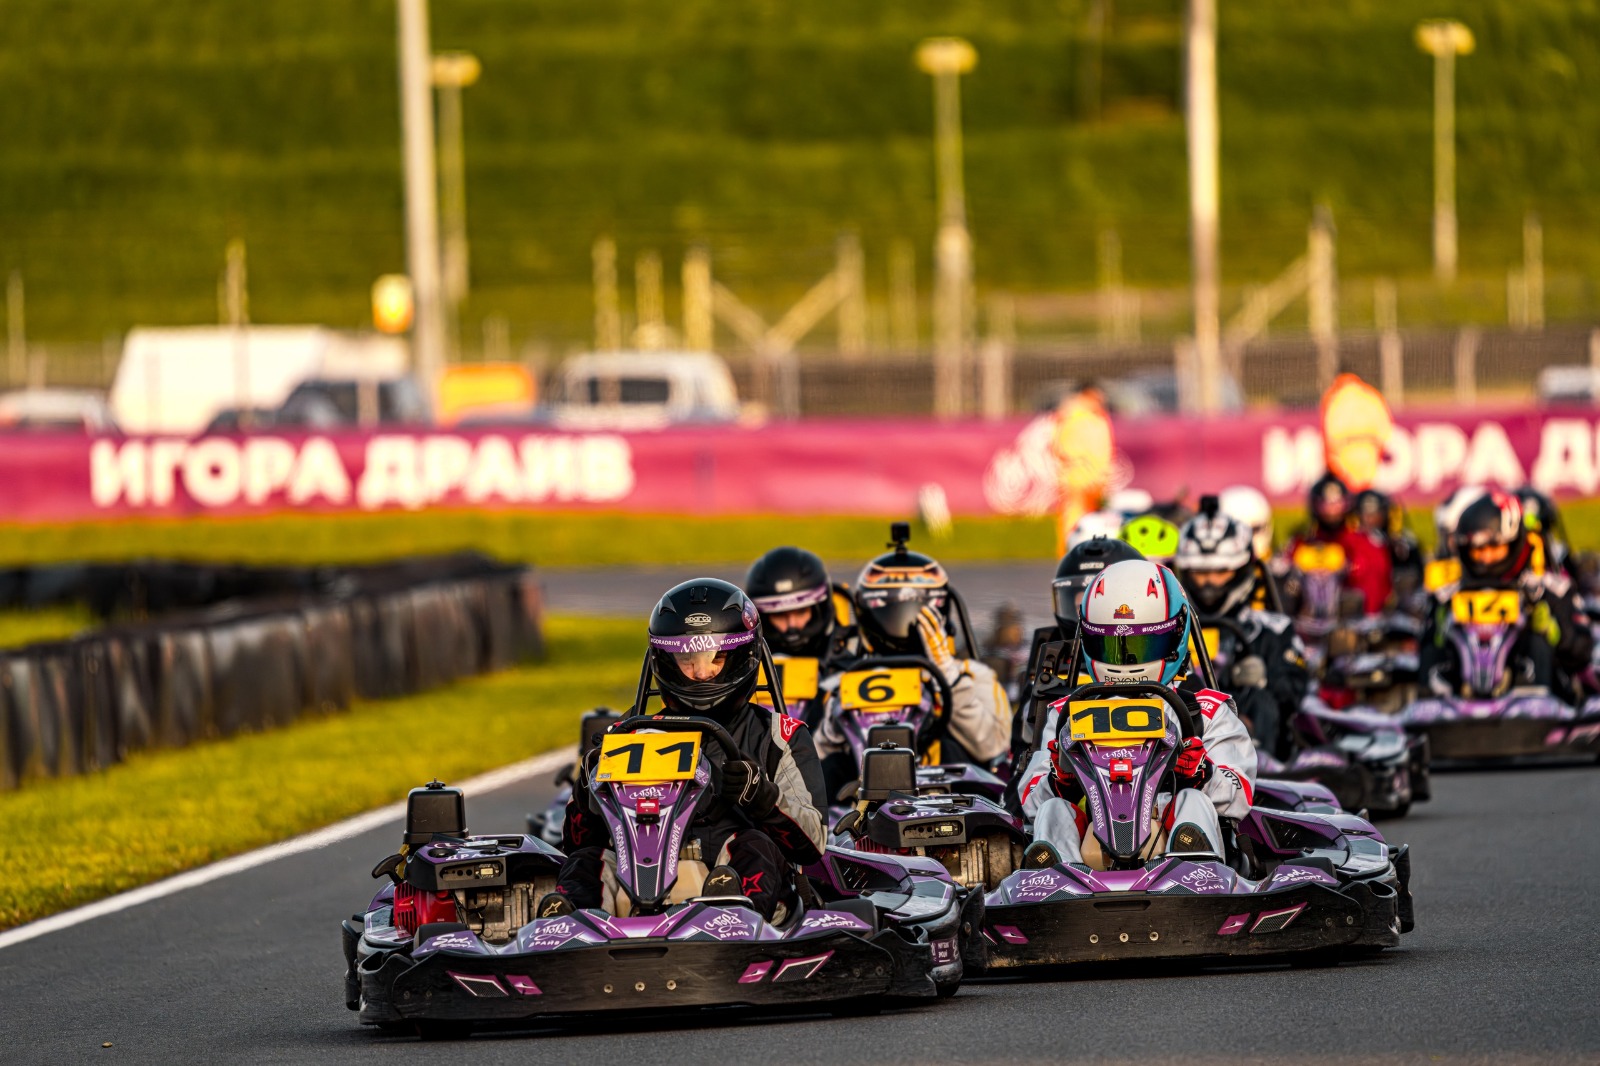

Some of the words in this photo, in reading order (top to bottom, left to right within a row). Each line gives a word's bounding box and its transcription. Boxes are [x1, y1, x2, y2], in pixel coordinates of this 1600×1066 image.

[90, 438, 350, 506] ИГОРА
[1262, 422, 1526, 494] ИОРА
[1530, 417, 1600, 496] Д
[857, 674, 896, 703] 6
[1072, 705, 1163, 733] 10
[604, 742, 695, 774] 11
[1088, 784, 1105, 832] #IGORADRIVE
[1142, 783, 1154, 834] #IGORADRIVE
[615, 824, 629, 875] #IGORADRIVE
[668, 822, 681, 876] #IGORADRIVE
